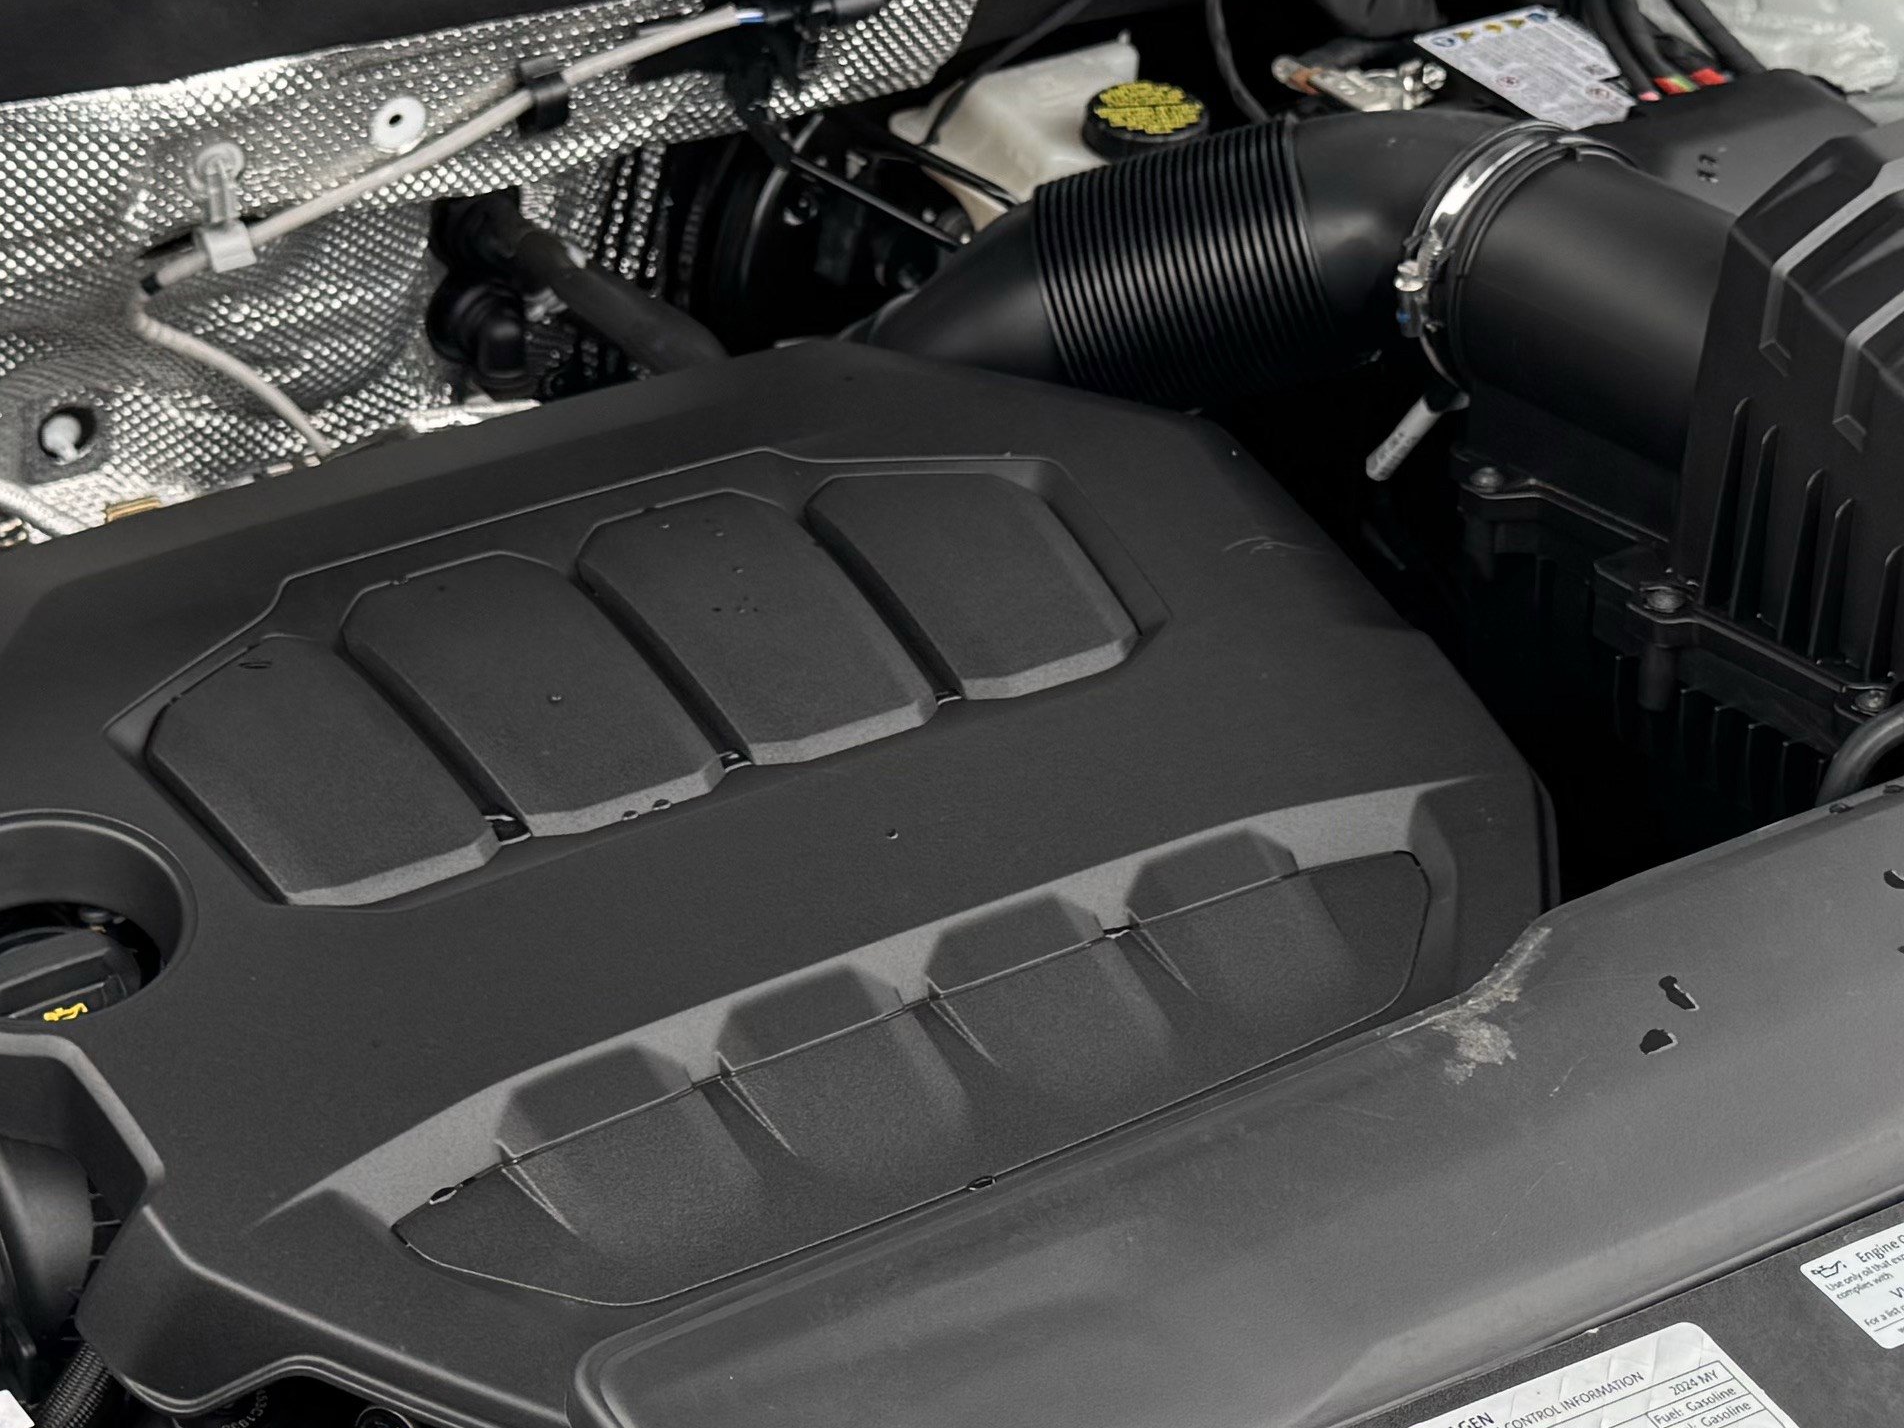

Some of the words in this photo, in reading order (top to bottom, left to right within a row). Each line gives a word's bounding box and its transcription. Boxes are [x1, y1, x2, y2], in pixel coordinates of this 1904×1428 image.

[1854, 1238, 1904, 1265] Engine
[1559, 1372, 1645, 1410] INFORMATION
[1667, 1377, 1700, 1395] 2024
[1696, 1369, 1721, 1384] MY
[1652, 1406, 1685, 1425] Fuel:
[1683, 1386, 1738, 1412] Gasoline
[1698, 1400, 1753, 1427] Gasoline
